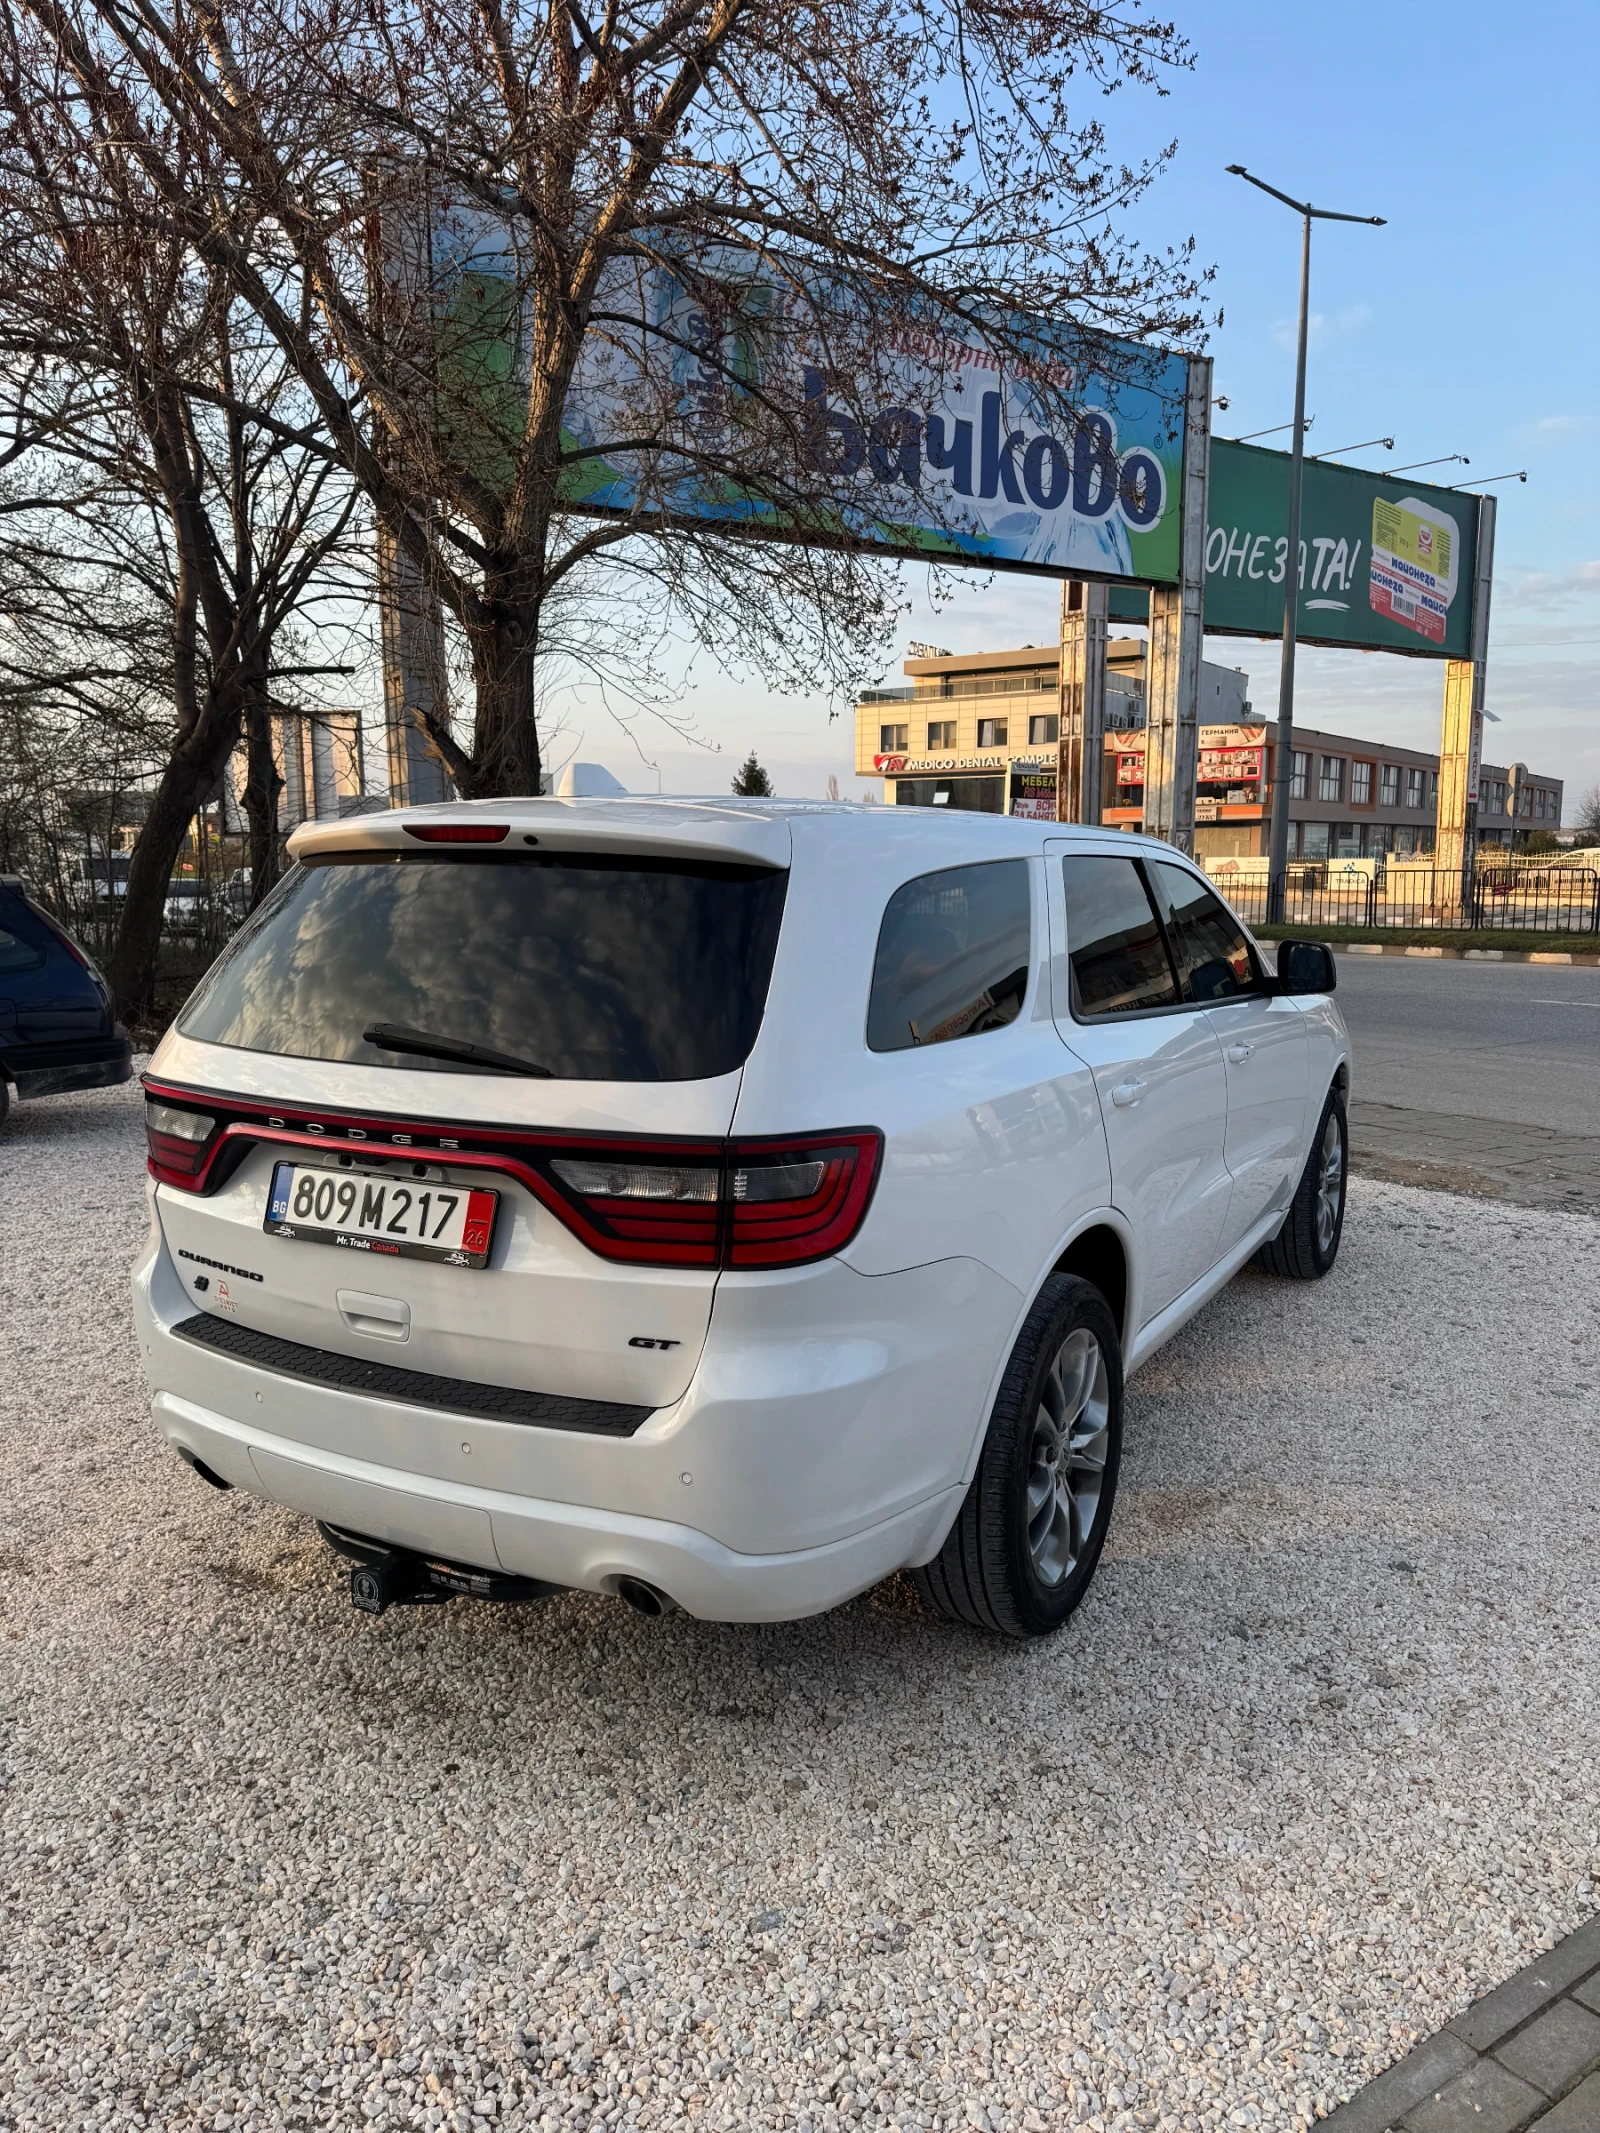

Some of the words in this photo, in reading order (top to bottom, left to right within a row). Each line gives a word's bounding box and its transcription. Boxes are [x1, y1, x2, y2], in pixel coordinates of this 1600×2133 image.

[1201, 728, 1239, 736] ГЕРМАНИЯ
[909, 757, 955, 771] MEDICO
[958, 756, 1002, 769] DENTAL
[1471, 751, 1479, 790] БАНЯТА
[268, 1117, 460, 1149] DODGE
[271, 1199, 288, 1214] BG
[293, 1174, 460, 1240] 809M217
[467, 1228, 485, 1247] 26
[336, 1234, 349, 1246] Mr.
[350, 1236, 371, 1249] Trade
[371, 1241, 400, 1254] Canada
[178, 1248, 264, 1282] DURANGO
[627, 1336, 681, 1350] GT
